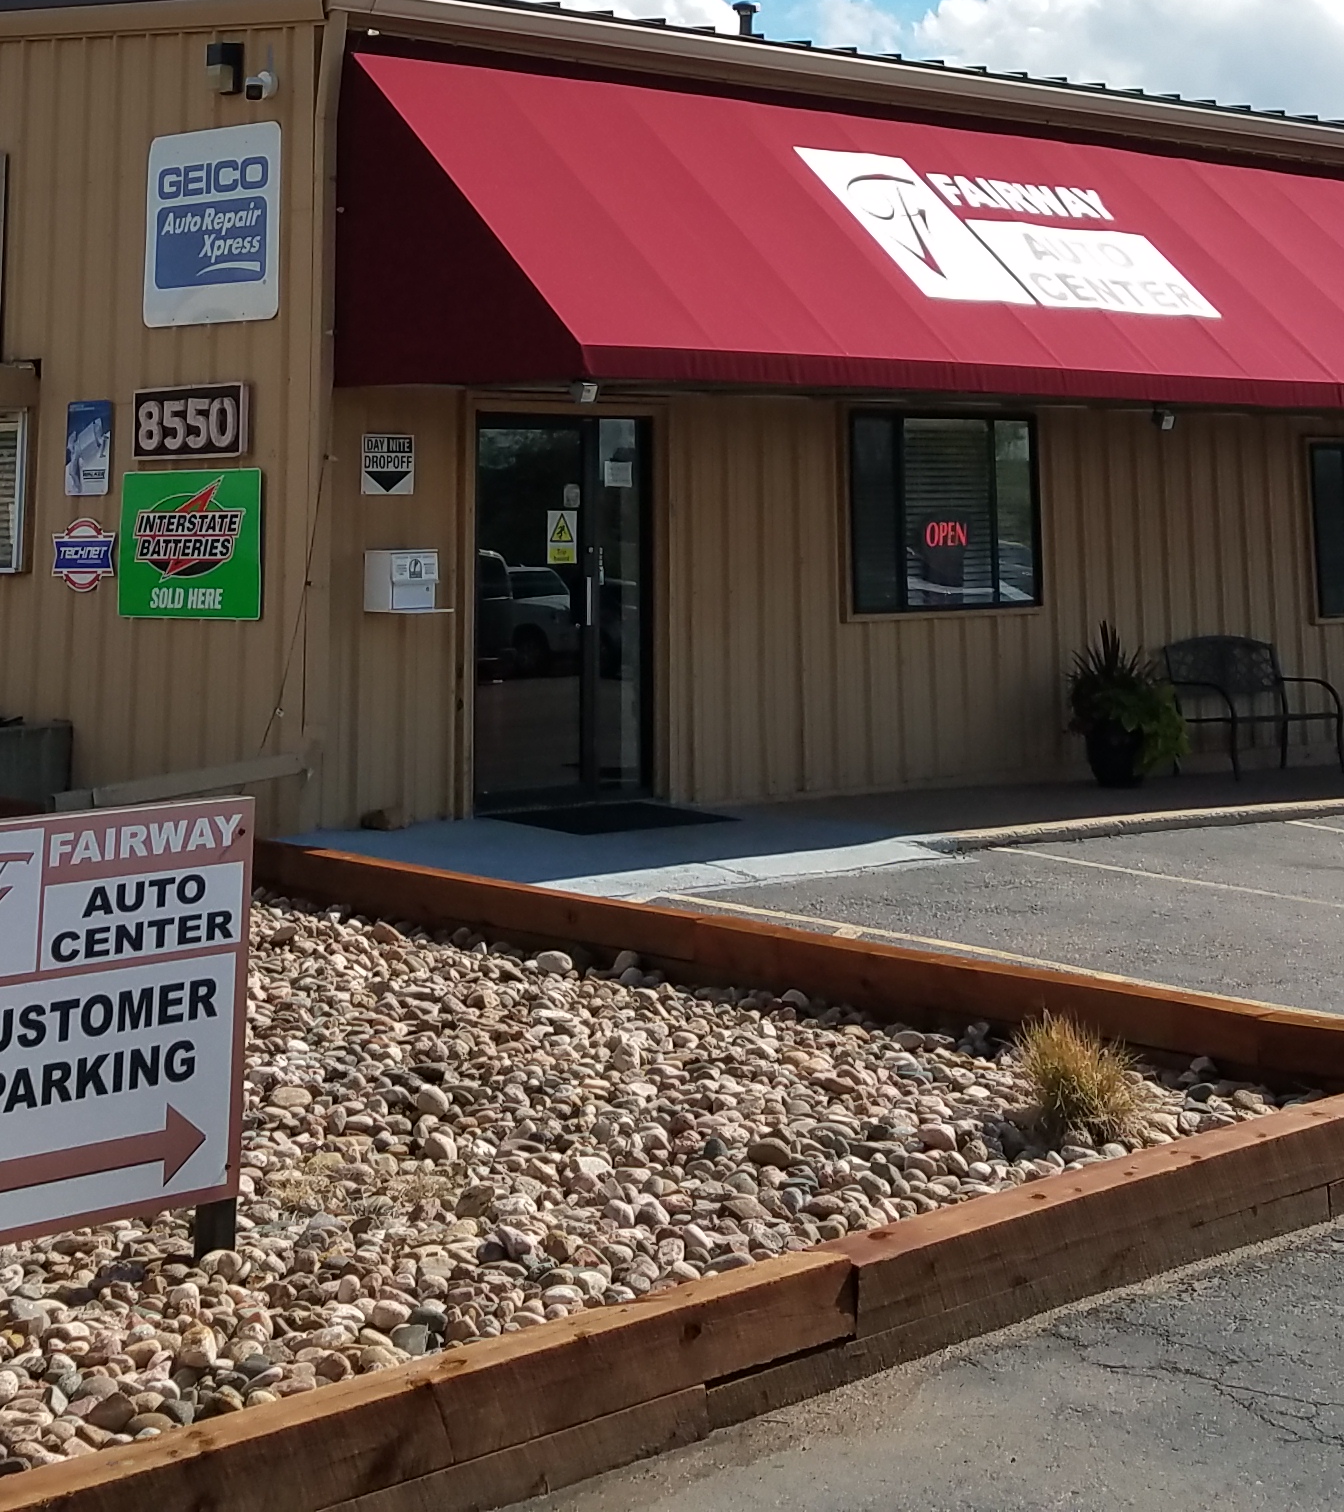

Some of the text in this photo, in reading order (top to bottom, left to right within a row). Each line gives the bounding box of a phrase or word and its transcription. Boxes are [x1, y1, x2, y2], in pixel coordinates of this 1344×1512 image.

[158, 156, 269, 200] GEICO
[926, 172, 1115, 221] FAIRWAY
[161, 201, 262, 236] Auto Repair
[198, 233, 262, 264] Xpress
[1022, 232, 1134, 268] AUTO
[1029, 272, 1204, 311] CENTER
[138, 396, 238, 451] 8550
[364, 454, 413, 470] DROPOFF
[366, 438, 411, 452] DAY NITE
[137, 513, 240, 534] INTERSTATE
[925, 521, 968, 548] OPEN
[139, 538, 232, 558] BATTERIES
[150, 586, 224, 610] SOLD HERE
[48, 813, 244, 869] FAIRWAY
[81, 874, 207, 919] AUTO
[50, 909, 235, 963] CENTER
